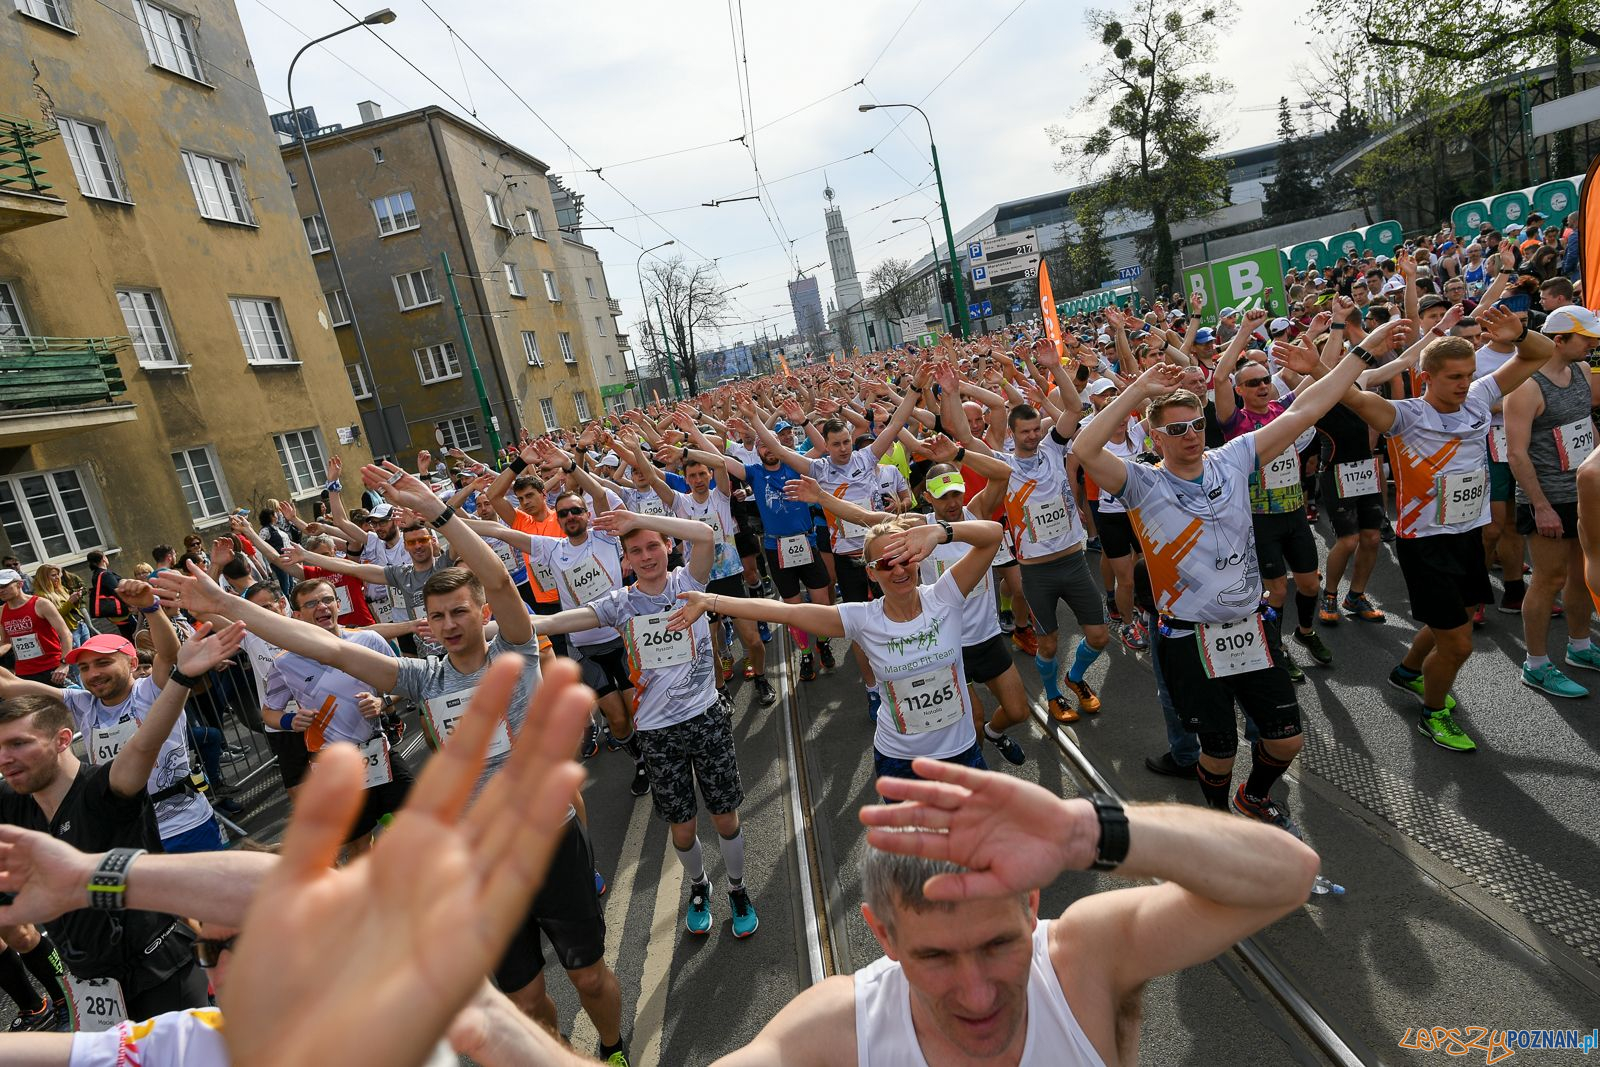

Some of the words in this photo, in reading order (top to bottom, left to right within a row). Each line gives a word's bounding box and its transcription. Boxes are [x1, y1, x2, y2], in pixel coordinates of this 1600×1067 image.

[1016, 244, 1032, 255] 217
[975, 268, 983, 279] P
[1024, 268, 1036, 278] 85
[1120, 267, 1141, 279] TAXI
[1228, 261, 1263, 300] B
[1190, 273, 1207, 307] B
[923, 335, 933, 346] B
[1271, 458, 1295, 472] 6751
[1344, 470, 1373, 483] 11749
[1452, 485, 1483, 503] 5888
[1035, 508, 1065, 525] 11202
[788, 545, 804, 554] 626
[574, 568, 600, 588] 4694
[642, 629, 682, 646] 2666
[1215, 632, 1254, 652] 8109
[16, 642, 35, 651] 9283
[884, 661, 918, 674] Marago
[920, 657, 932, 665] Fit
[934, 648, 955, 662] Team
[904, 685, 954, 711] 11265
[85, 996, 121, 1018] 2871
